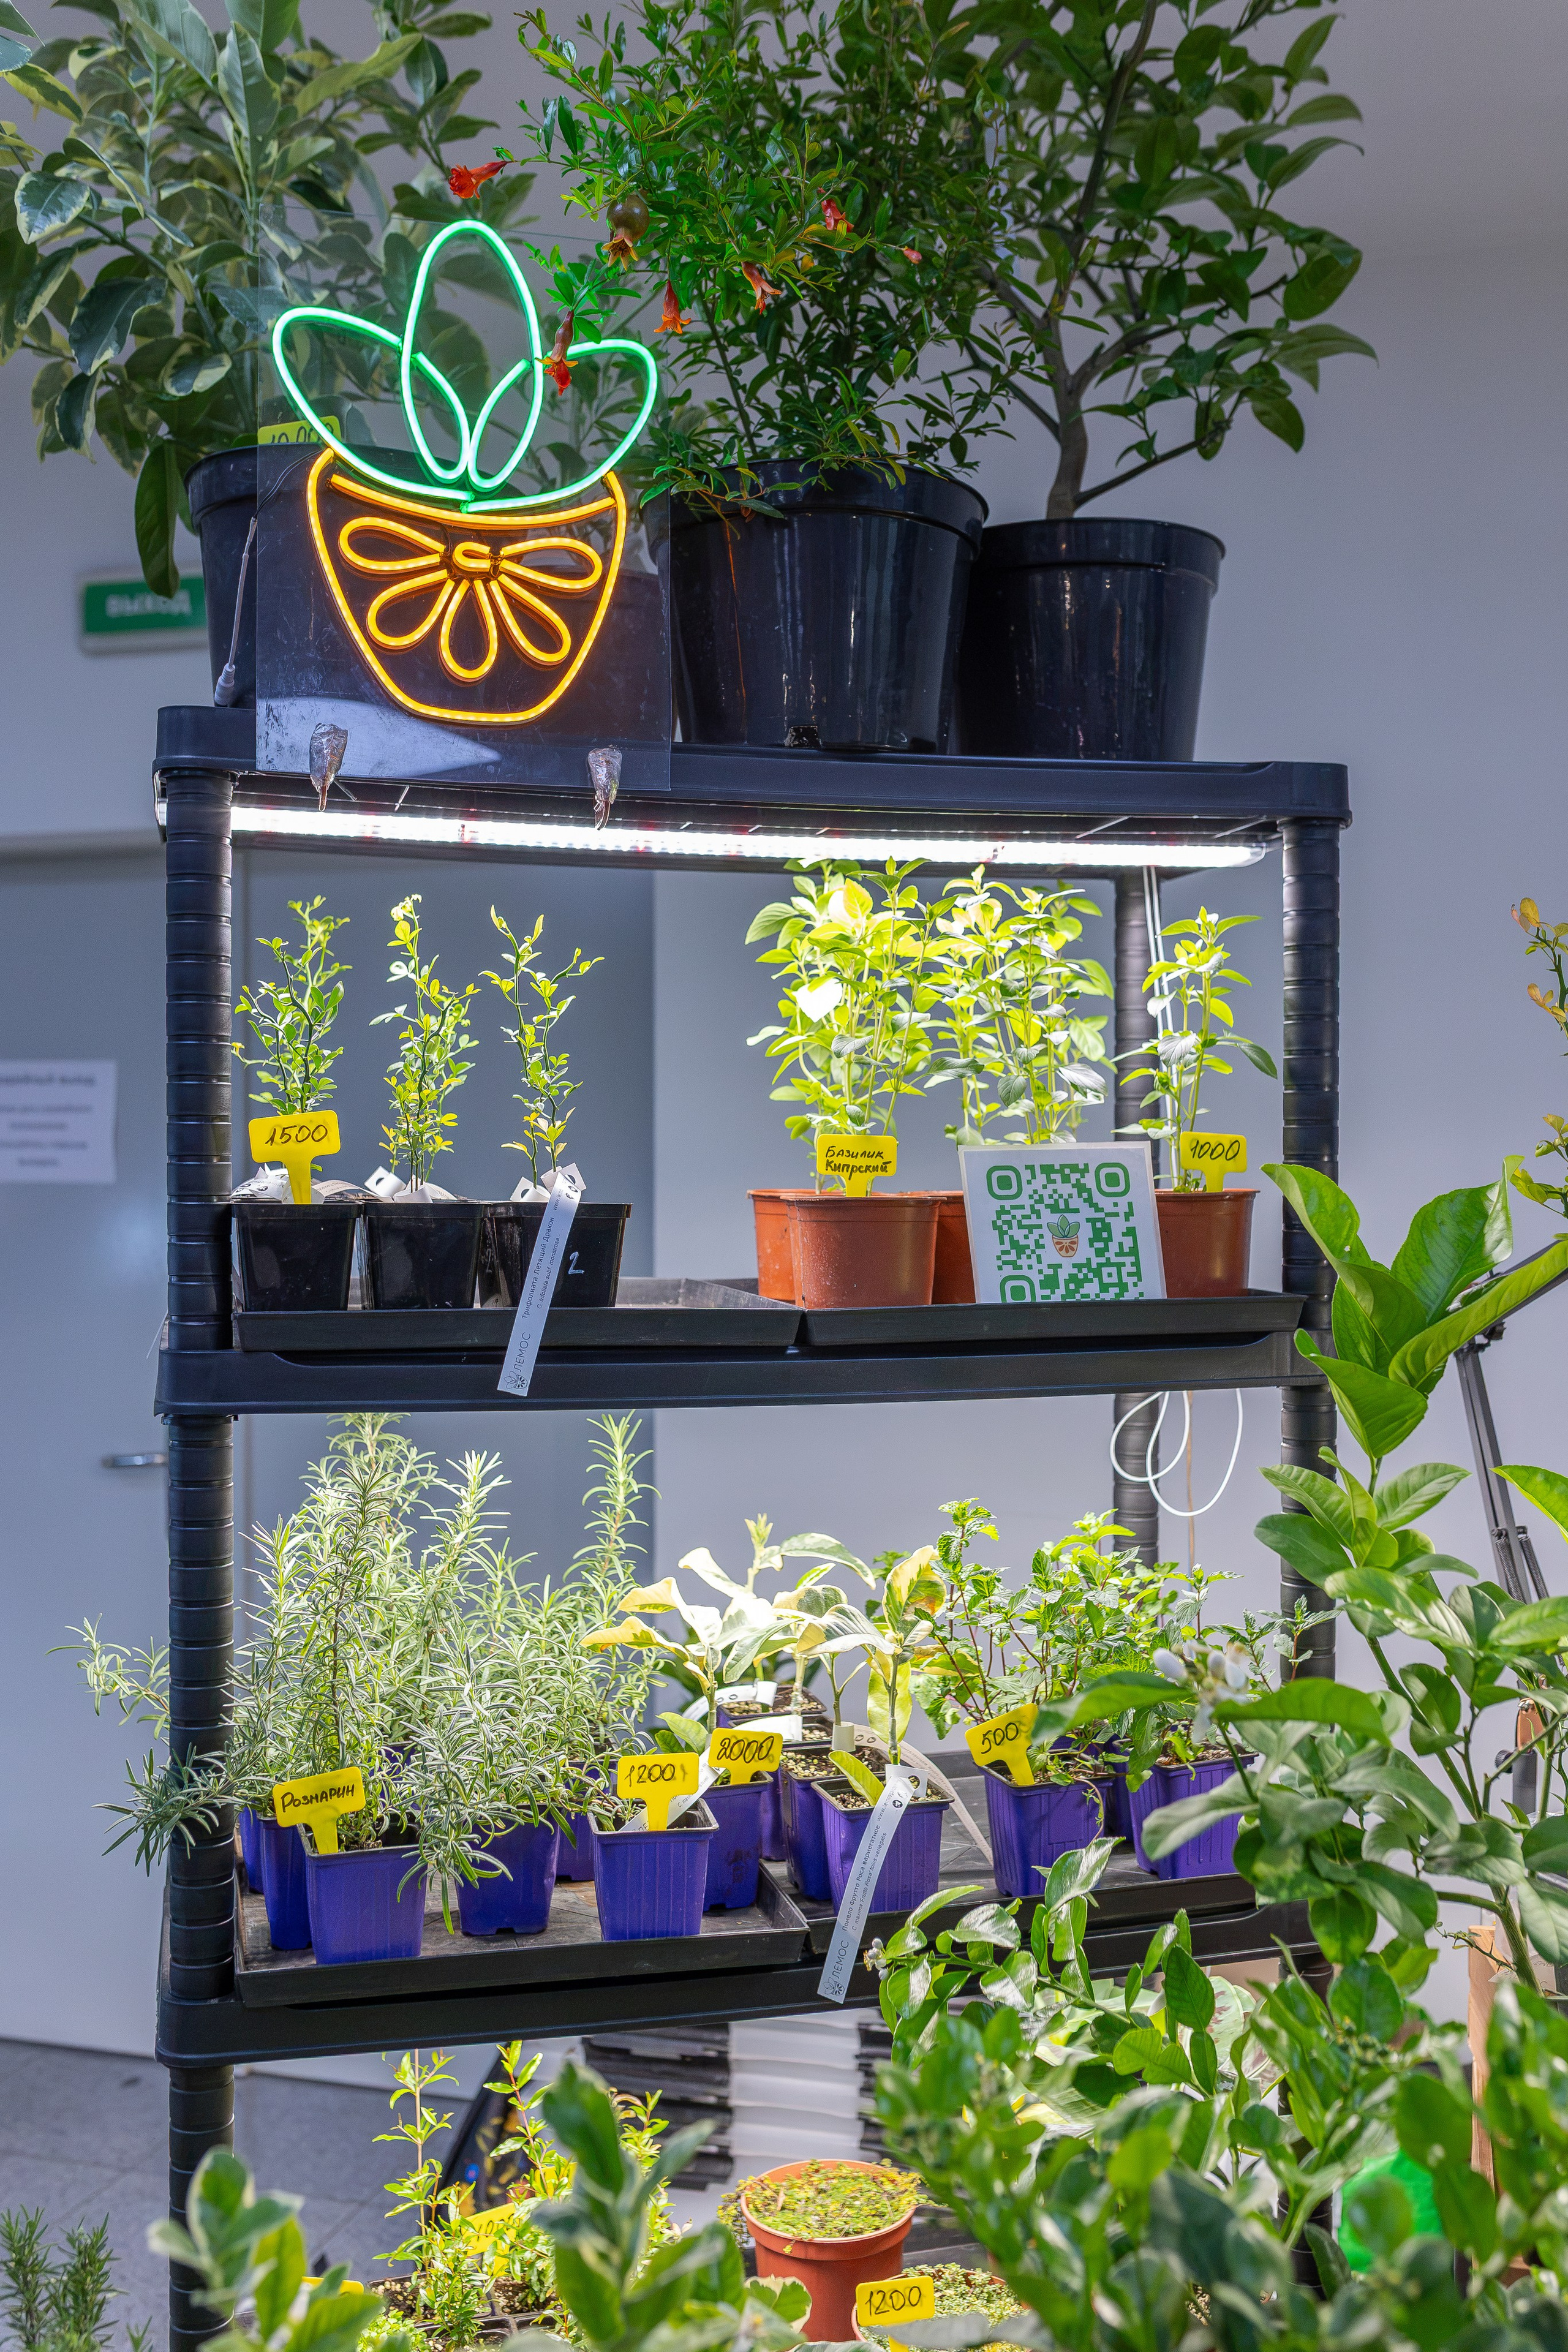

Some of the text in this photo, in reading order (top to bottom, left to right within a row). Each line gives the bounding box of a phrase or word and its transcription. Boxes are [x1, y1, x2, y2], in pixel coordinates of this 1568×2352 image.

[265, 1125, 328, 1145] 1500
[1191, 1140, 1240, 1161] 1000
[825, 1159, 892, 1180] Кипрский
[522, 1217, 554, 1319] Трифолиата Летящий Дракон
[568, 1251, 585, 1274] 2
[513, 1332, 531, 1373] ЛЕМОС
[717, 1736, 774, 1763] 2000
[981, 1722, 1019, 1754] 500
[842, 1907, 853, 1931] Помело
[850, 1883, 860, 1905] Фрутто
[856, 1867, 865, 1882] Роса
[862, 1825, 881, 1865] вариегатное
[832, 1940, 849, 1980] ЛЕМОС
[864, 2286, 921, 2316] 1200
